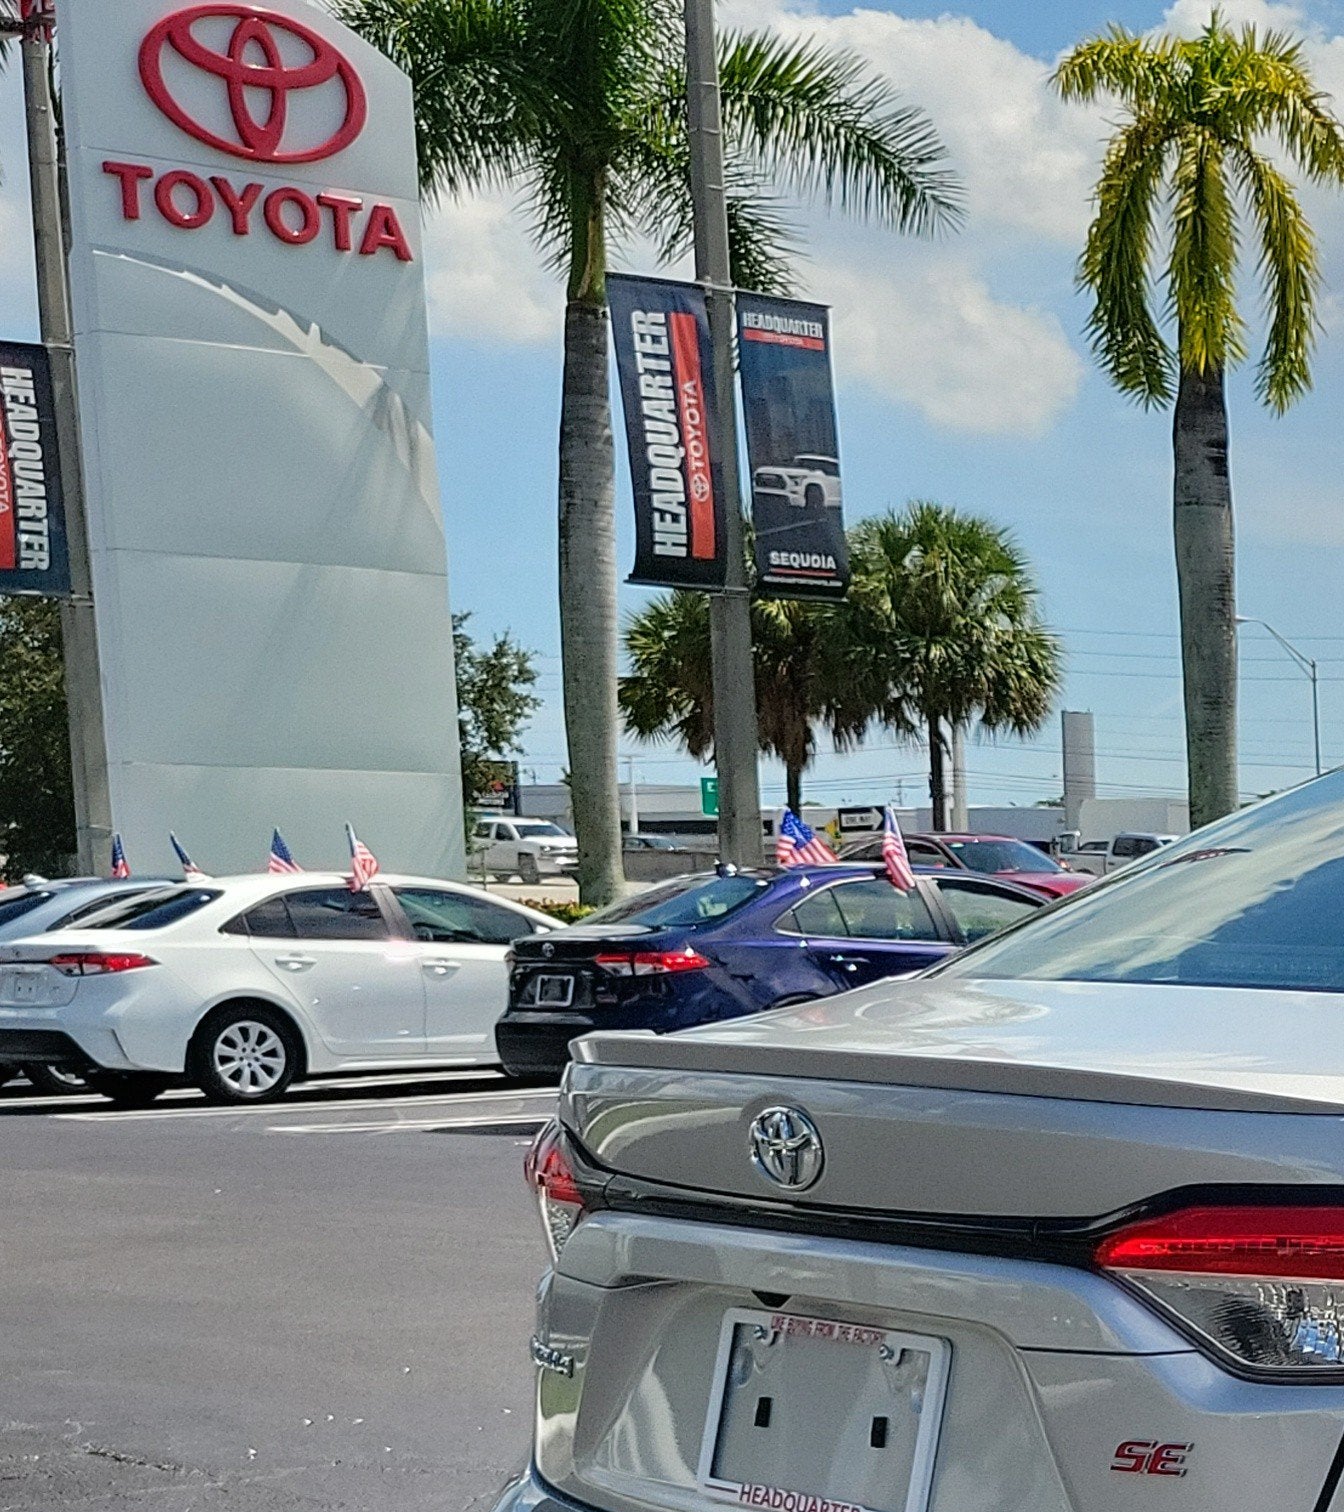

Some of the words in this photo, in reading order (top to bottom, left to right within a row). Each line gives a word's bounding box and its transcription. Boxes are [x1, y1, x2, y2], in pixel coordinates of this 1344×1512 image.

[102, 161, 413, 262] TOYOTA
[0, 366, 51, 571] HEADQUARTER
[631, 309, 688, 558] HEADQUARTER
[681, 380, 704, 472] TOYOTA
[769, 550, 837, 570] SEQUOIA
[1110, 1440, 1195, 1478] SE
